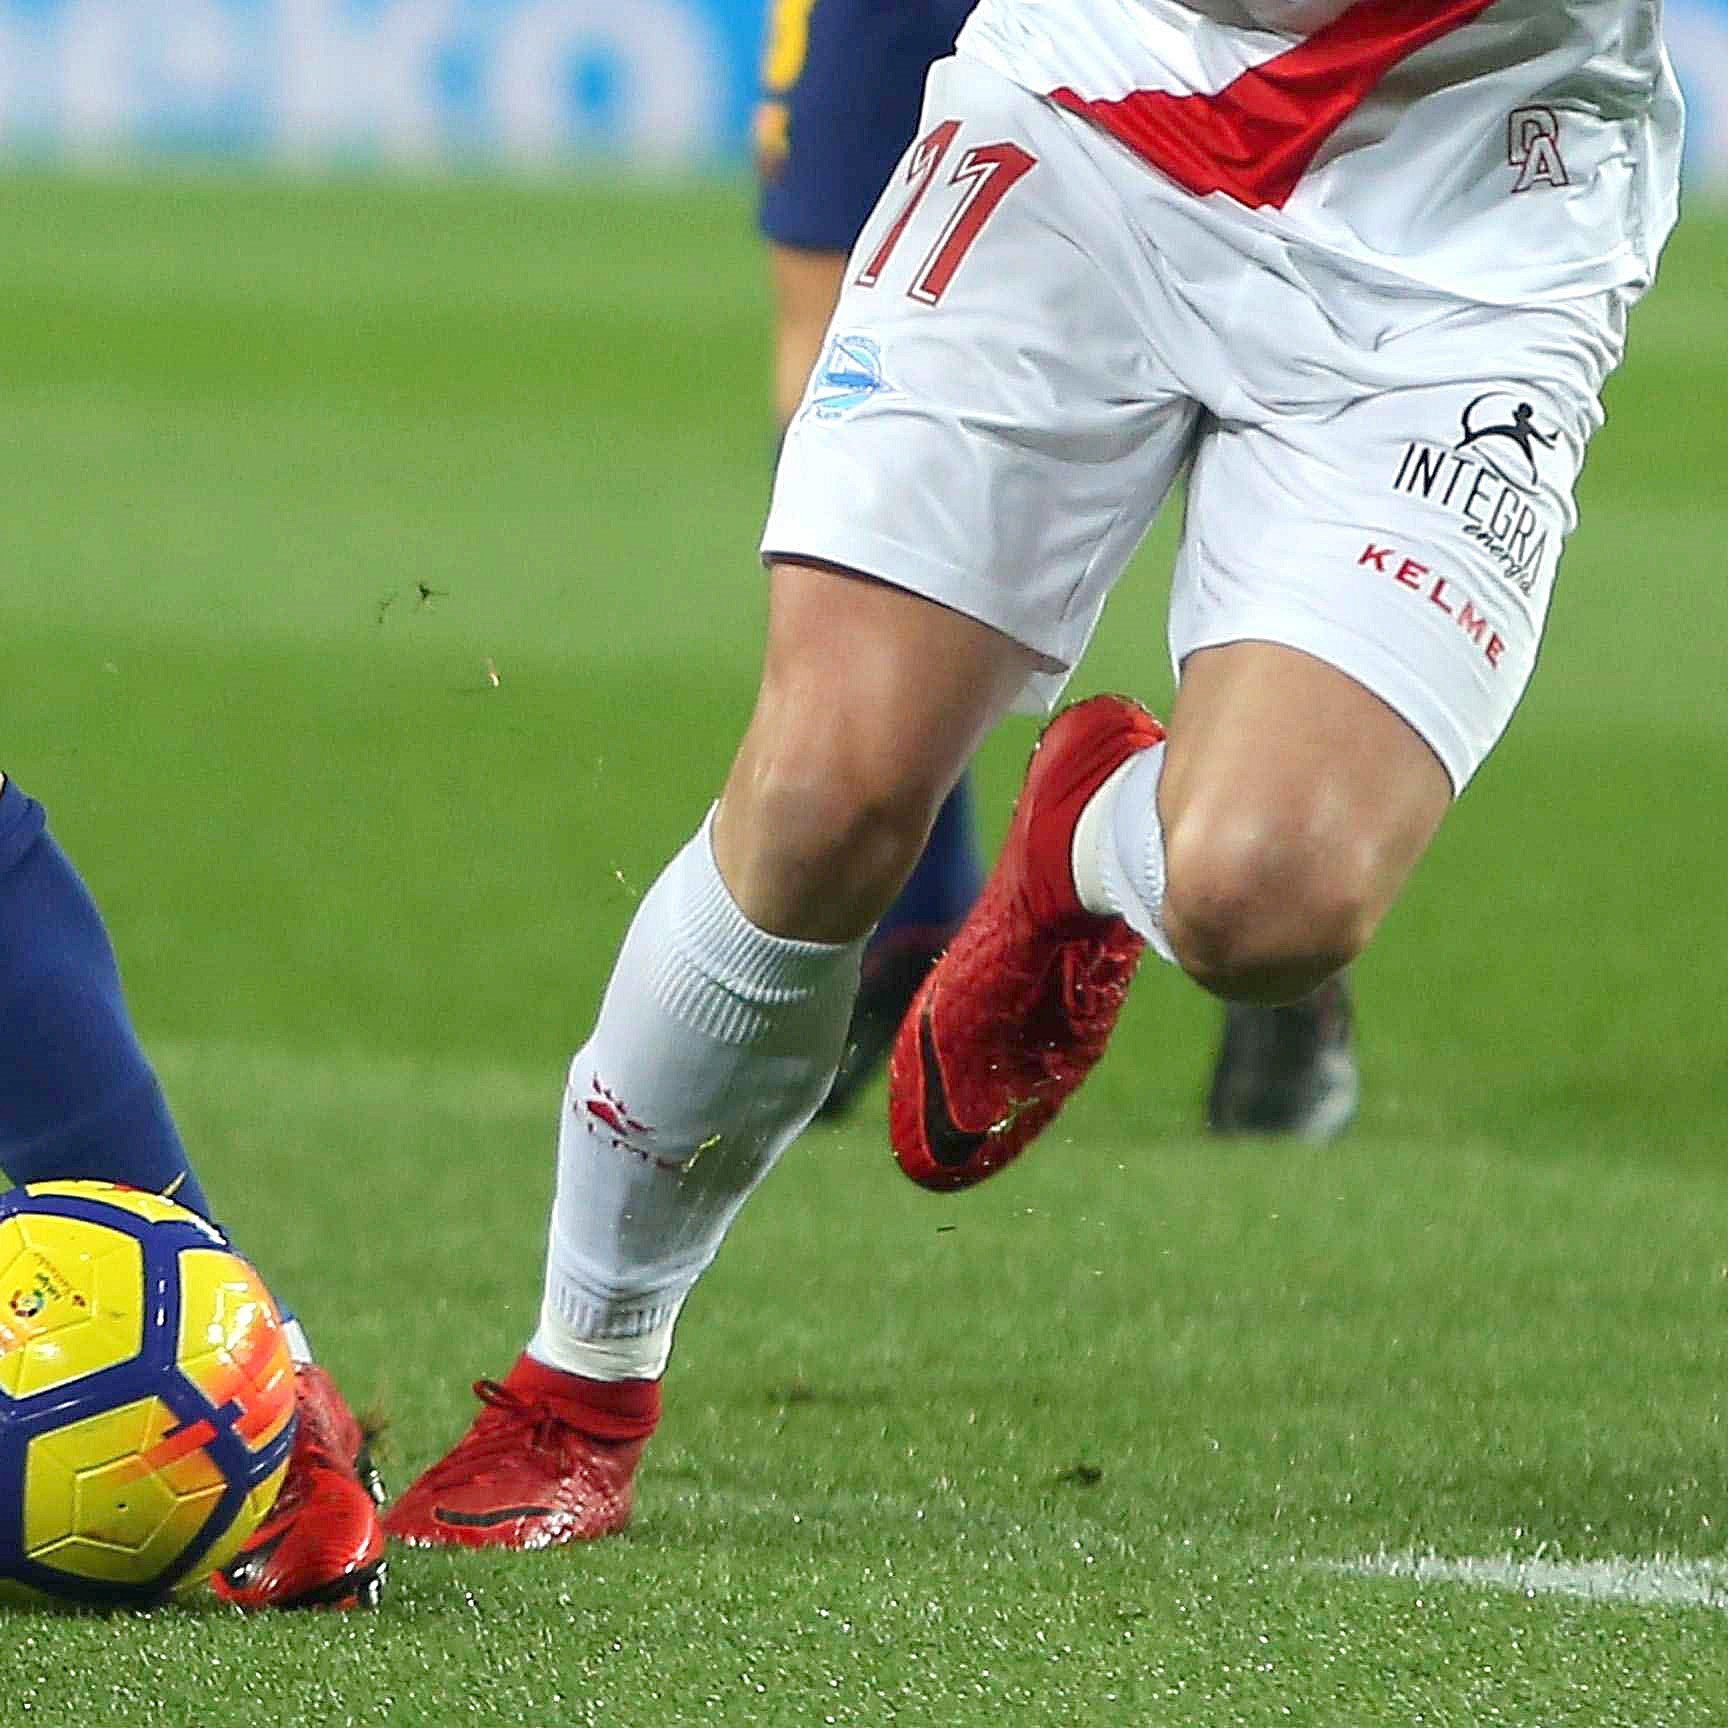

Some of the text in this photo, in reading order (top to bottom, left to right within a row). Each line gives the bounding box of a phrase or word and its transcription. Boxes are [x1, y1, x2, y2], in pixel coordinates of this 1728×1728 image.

[854, 119, 1040, 307] 11
[1393, 442, 1548, 588] INTEGRA
[1358, 544, 1506, 670] KELME
